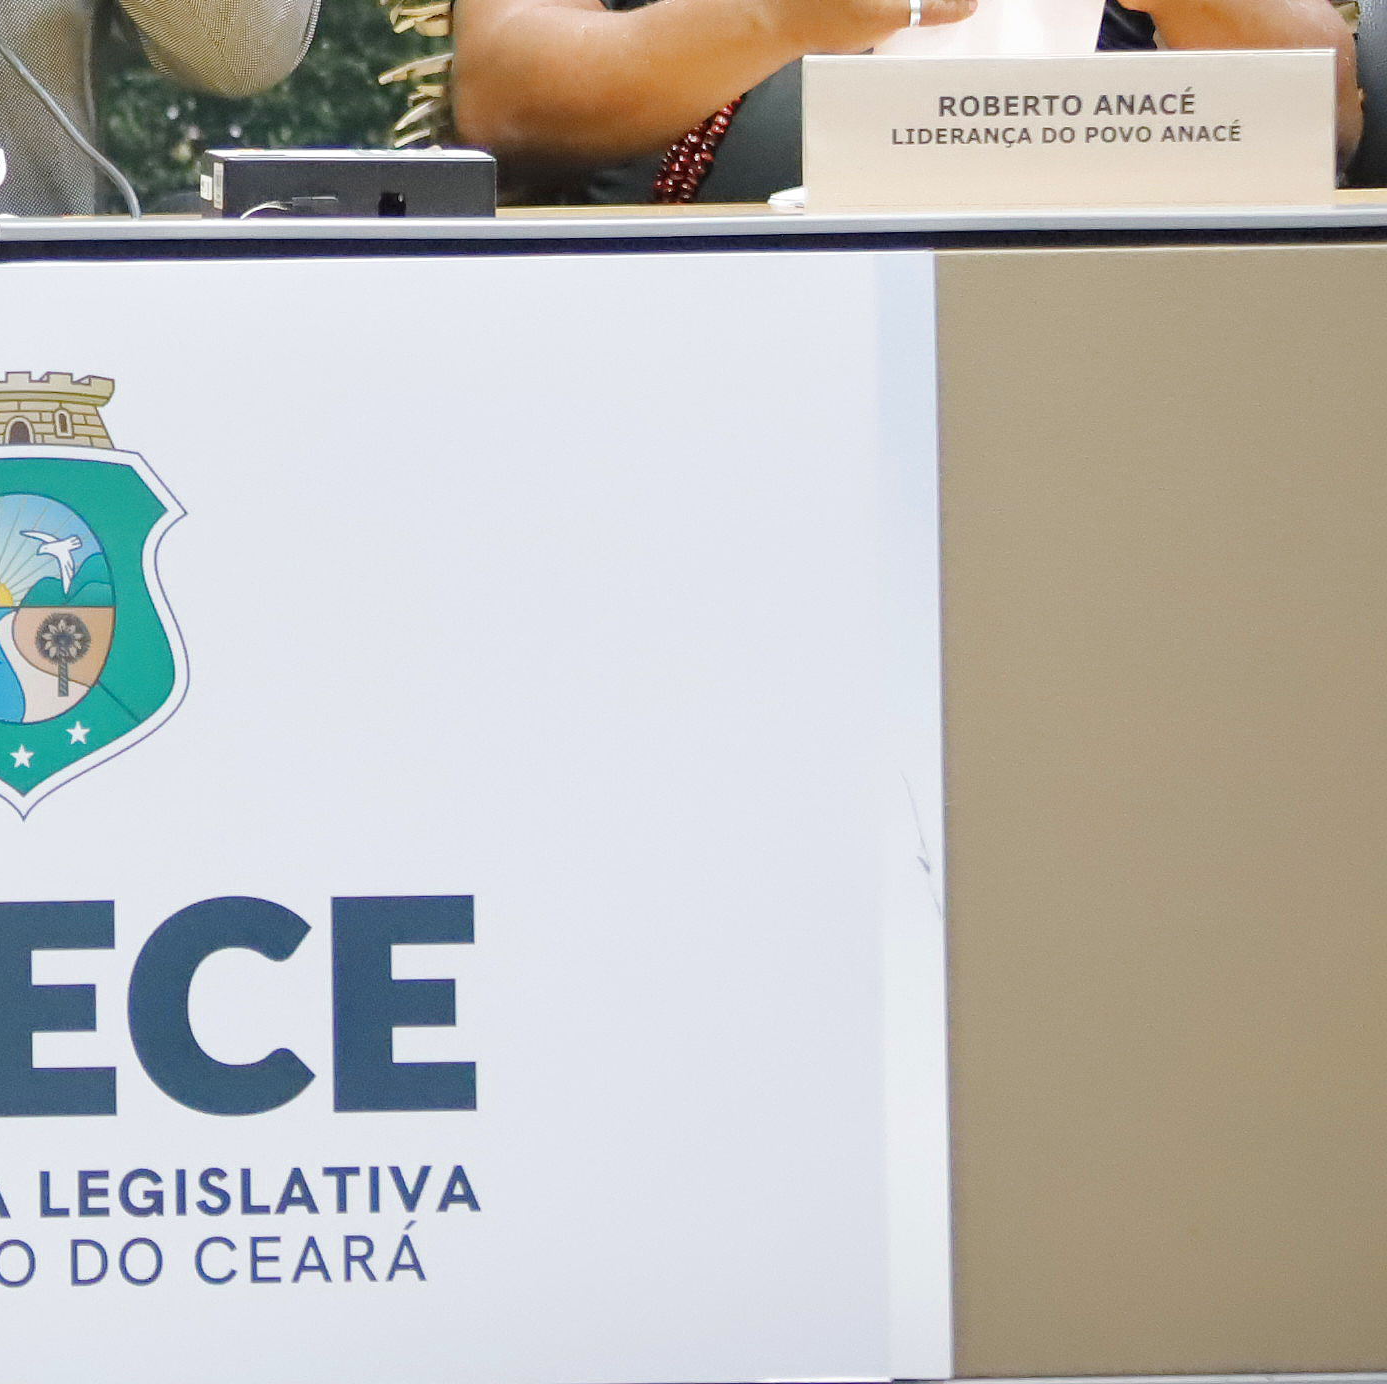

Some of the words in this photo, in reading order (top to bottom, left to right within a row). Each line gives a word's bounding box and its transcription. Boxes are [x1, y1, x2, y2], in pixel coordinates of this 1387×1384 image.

[938, 94, 1082, 117] ROBERTO
[1093, 86, 1196, 116] ANACÉ
[892, 127, 1032, 149] LIDERANÇA
[1041, 126, 1076, 144] DO
[1085, 125, 1152, 144] POVO
[1160, 119, 1242, 143] ANACÉ
[39, 1164, 481, 1218] LEGISLATIVA
[70, 1236, 164, 1287] DO
[194, 1220, 427, 1286] CEARÁ
